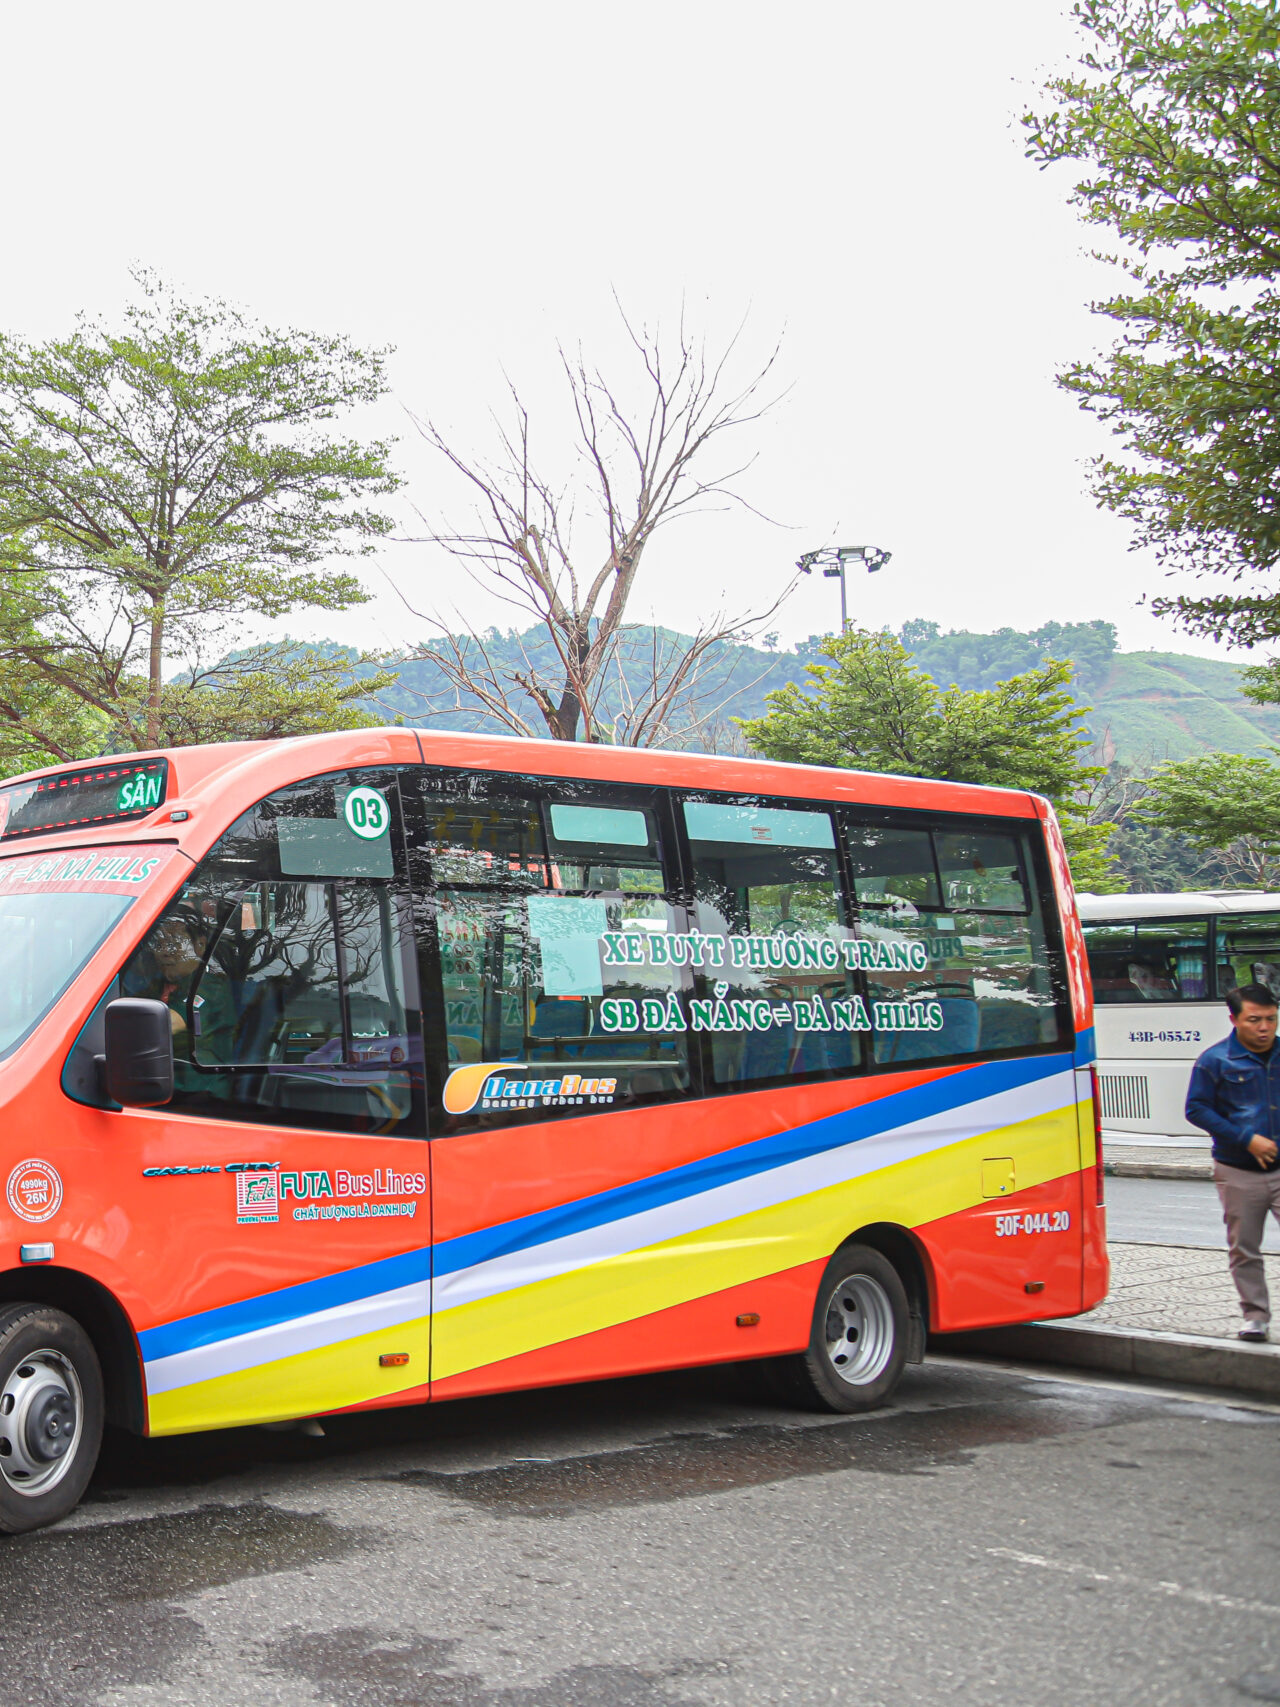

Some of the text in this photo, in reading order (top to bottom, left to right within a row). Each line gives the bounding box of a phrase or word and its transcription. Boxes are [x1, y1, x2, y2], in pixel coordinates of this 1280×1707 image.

[119, 773, 163, 810] SÂN
[352, 797, 382, 828] 03
[90, 856, 160, 883] HILLS
[602, 928, 928, 972] XE BUÝT PHƯƠNG TRANG
[600, 981, 944, 1032] SB ĐÀ NẴNG BÀ NÀ HILLS
[1128, 1030, 1201, 1042] 43B-055.72
[483, 1075, 618, 1098] DanaBus
[482, 1098, 535, 1109] Danang
[542, 1096, 584, 1106] Urban
[225, 1161, 281, 1173] CITY
[20, 1178, 48, 1190] 4990kg
[279, 1169, 426, 1199] FUTA Bus Lines
[26, 1192, 48, 1205] 26N
[293, 1201, 417, 1221] CHẤT LƯỢNG LÀ DANH DỰ
[995, 1210, 1070, 1237] 50F-044.20
